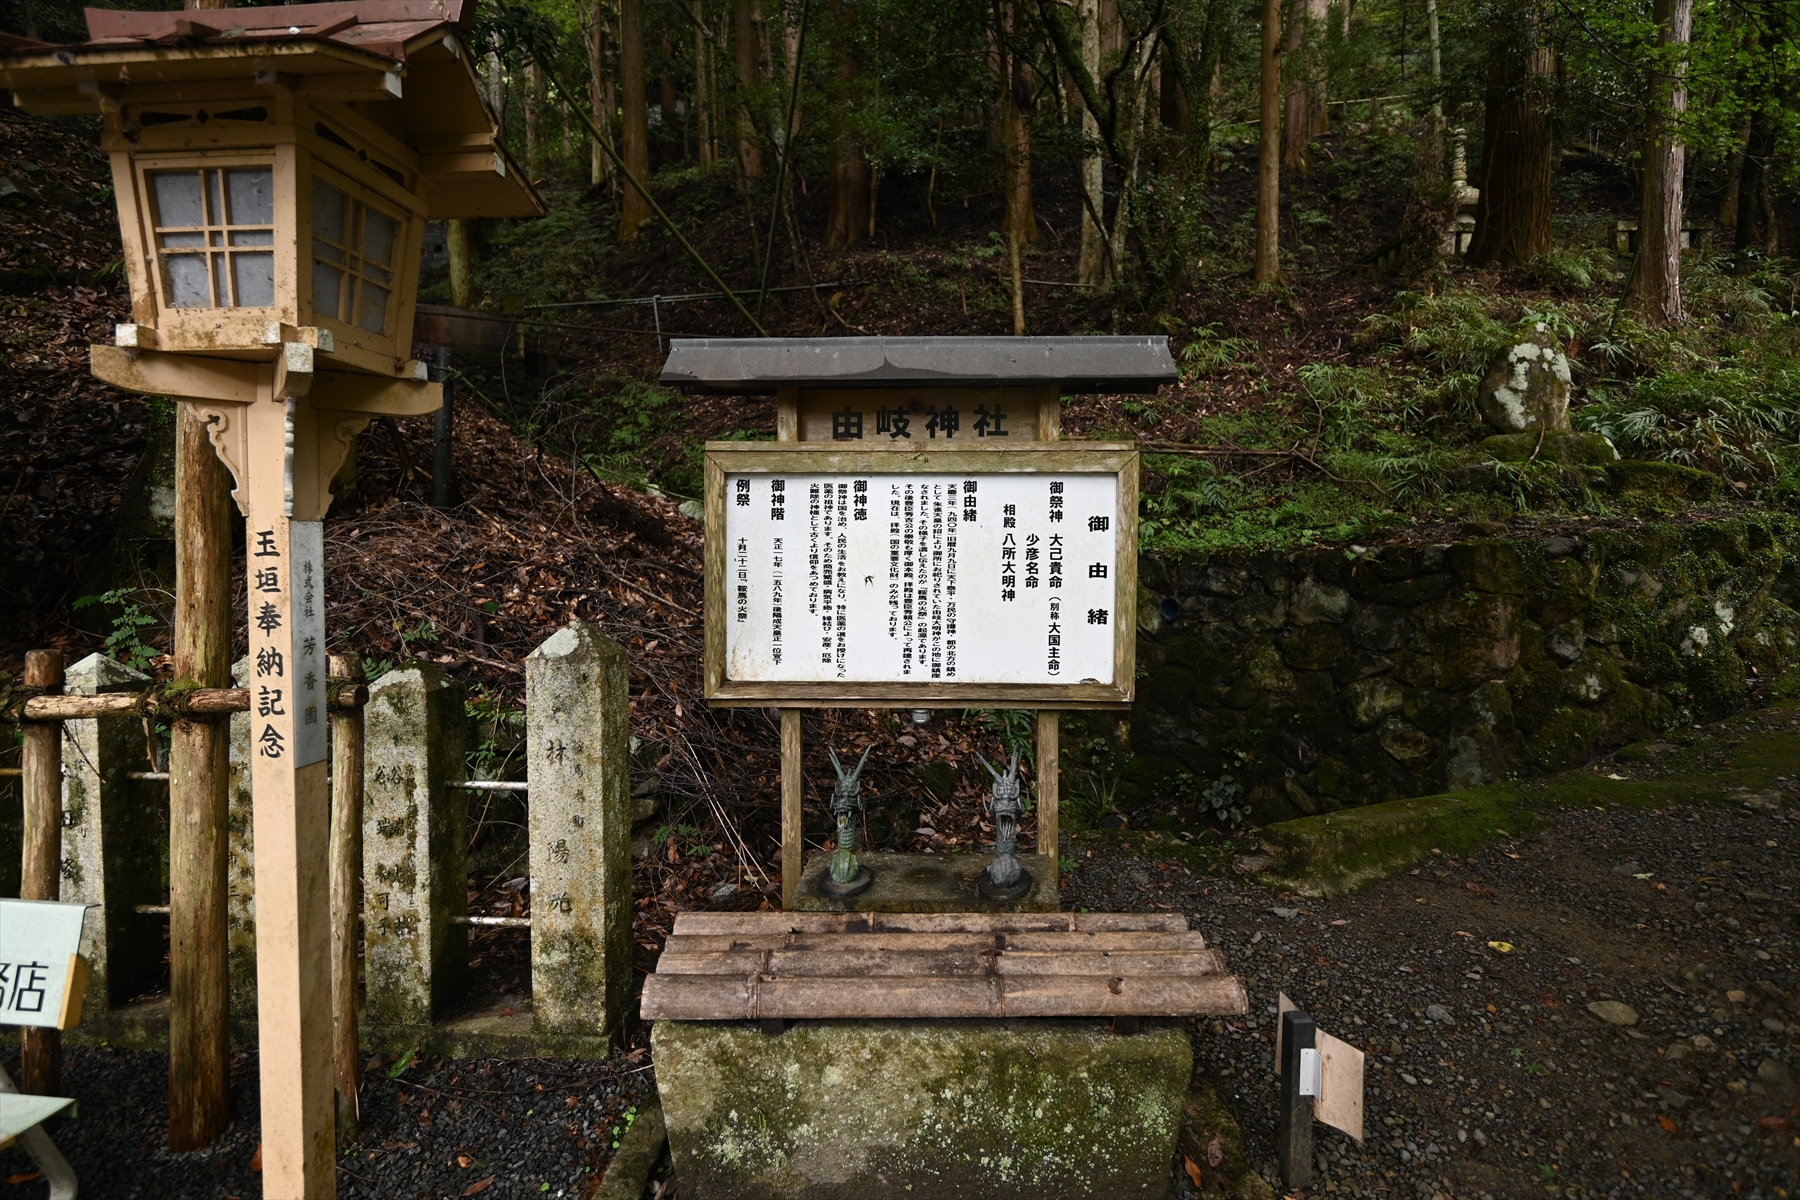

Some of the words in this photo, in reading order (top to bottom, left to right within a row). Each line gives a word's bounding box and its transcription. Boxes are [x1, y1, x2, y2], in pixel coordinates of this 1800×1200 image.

[832, 404, 1009, 439] 由岐神社
[736, 479, 750, 506] 例祭
[770, 479, 785, 521] 御神階
[853, 480, 868, 520] 御神徳
[962, 480, 978, 521] 御由緒
[1048, 481, 1064, 522] 御祭神
[1002, 504, 1017, 528] 相殿
[1001, 534, 1017, 601] 八所大明神
[1024, 534, 1041, 588] 少彦名命
[1087, 516, 1110, 624] 御由緒
[303, 560, 314, 619] 株式会社
[253, 529, 286, 760] 玉垣奉納記念
[303, 637, 318, 726] 芳香園
